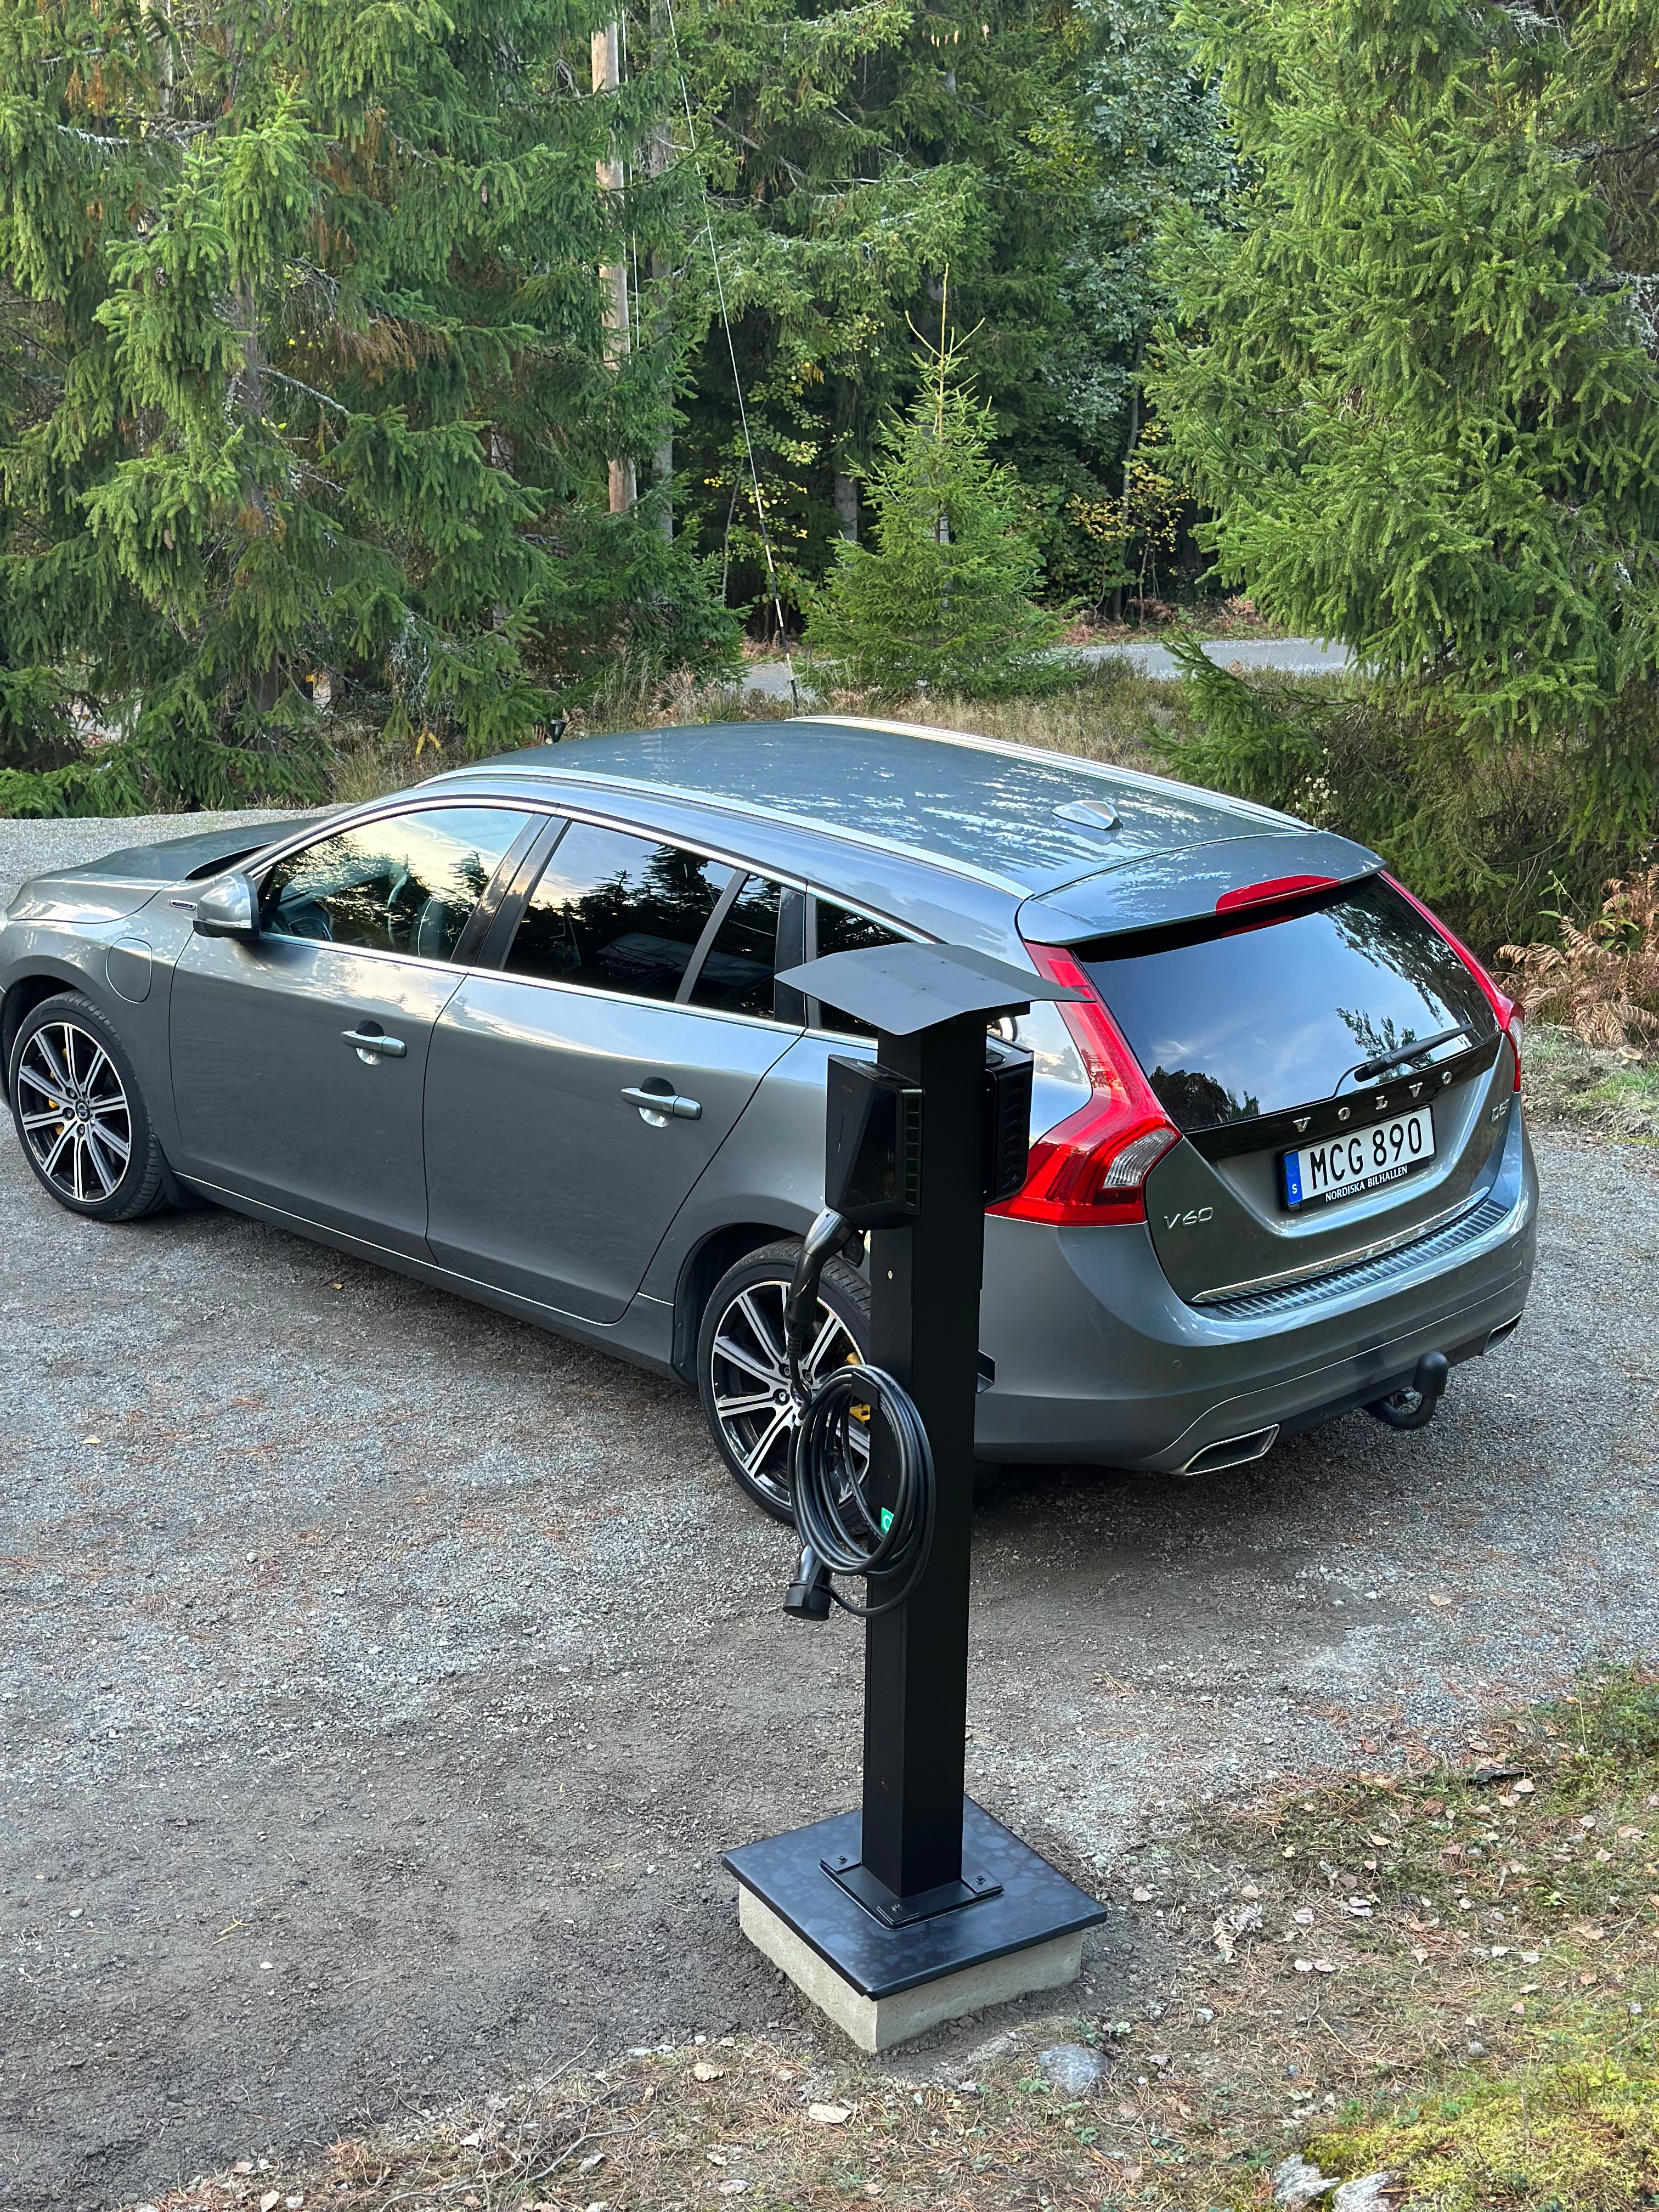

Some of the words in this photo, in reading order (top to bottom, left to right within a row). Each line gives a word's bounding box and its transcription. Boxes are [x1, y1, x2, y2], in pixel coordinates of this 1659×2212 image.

[1293, 1071, 1452, 1132] VOLVO
[1310, 1137, 1363, 1190] MCG
[1372, 1118, 1422, 1166] 890
[1291, 1183, 1298, 1194] S
[1325, 1181, 1365, 1202] NORDISKA
[1368, 1165, 1408, 1188] BILHALLEN
[1164, 1207, 1213, 1229] V60
